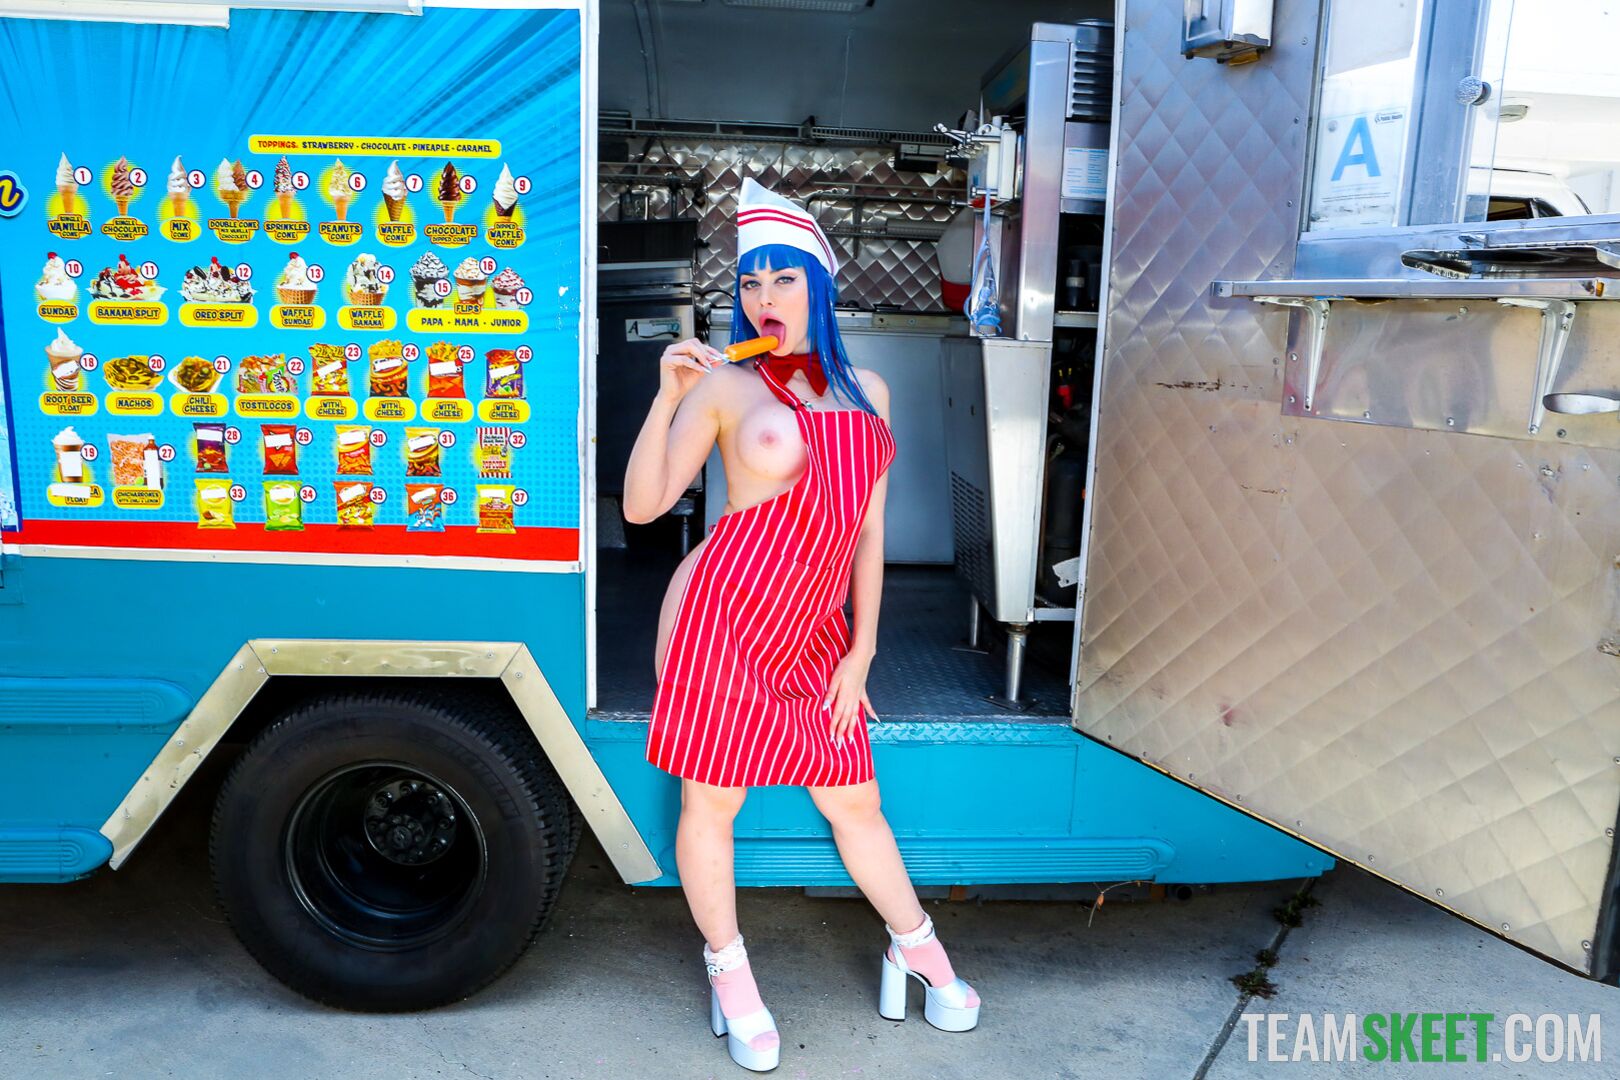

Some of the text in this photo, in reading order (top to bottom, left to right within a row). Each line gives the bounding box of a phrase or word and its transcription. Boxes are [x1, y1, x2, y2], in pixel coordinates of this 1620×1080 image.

[1330, 116, 1382, 182] A
[80, 171, 85, 182] 1
[135, 172, 141, 183] 2
[194, 174, 200, 184] 3
[252, 175, 258, 185] 4
[298, 176, 304, 187] 5
[355, 177, 361, 188] 6
[412, 178, 417, 189] 7
[464, 179, 471, 190] 8
[520, 180, 525, 191] 9
[50, 222, 89, 231] VANILLA
[68, 264, 79, 274] 10
[145, 266, 154, 275] 11
[483, 261, 493, 271] 16
[239, 268, 249, 277] 12
[310, 269, 321, 278] 13
[380, 270, 391, 280] 14
[438, 283, 448, 292] 15
[520, 292, 529, 301] 17
[41, 308, 75, 316] SUNDAE
[422, 318, 443, 326] PAPA
[348, 347, 359, 357] 23
[405, 348, 416, 357] 24
[461, 349, 471, 359] 25
[519, 350, 530, 359] 26
[83, 358, 94, 367] 18
[151, 359, 162, 369] 20
[217, 361, 226, 370] 21
[291, 361, 302, 371] 22
[241, 402, 292, 410] TOSTILOCOS
[227, 431, 237, 440] 28
[298, 432, 309, 441] 29
[372, 434, 384, 443] 30
[442, 434, 452, 444] 31
[513, 435, 523, 444] 32
[84, 448, 95, 457] 19
[162, 448, 172, 458] 27
[232, 489, 242, 498] 33
[302, 490, 313, 499] 34
[372, 491, 383, 500] 35
[443, 492, 454, 501] 36
[514, 493, 525, 502] 37
